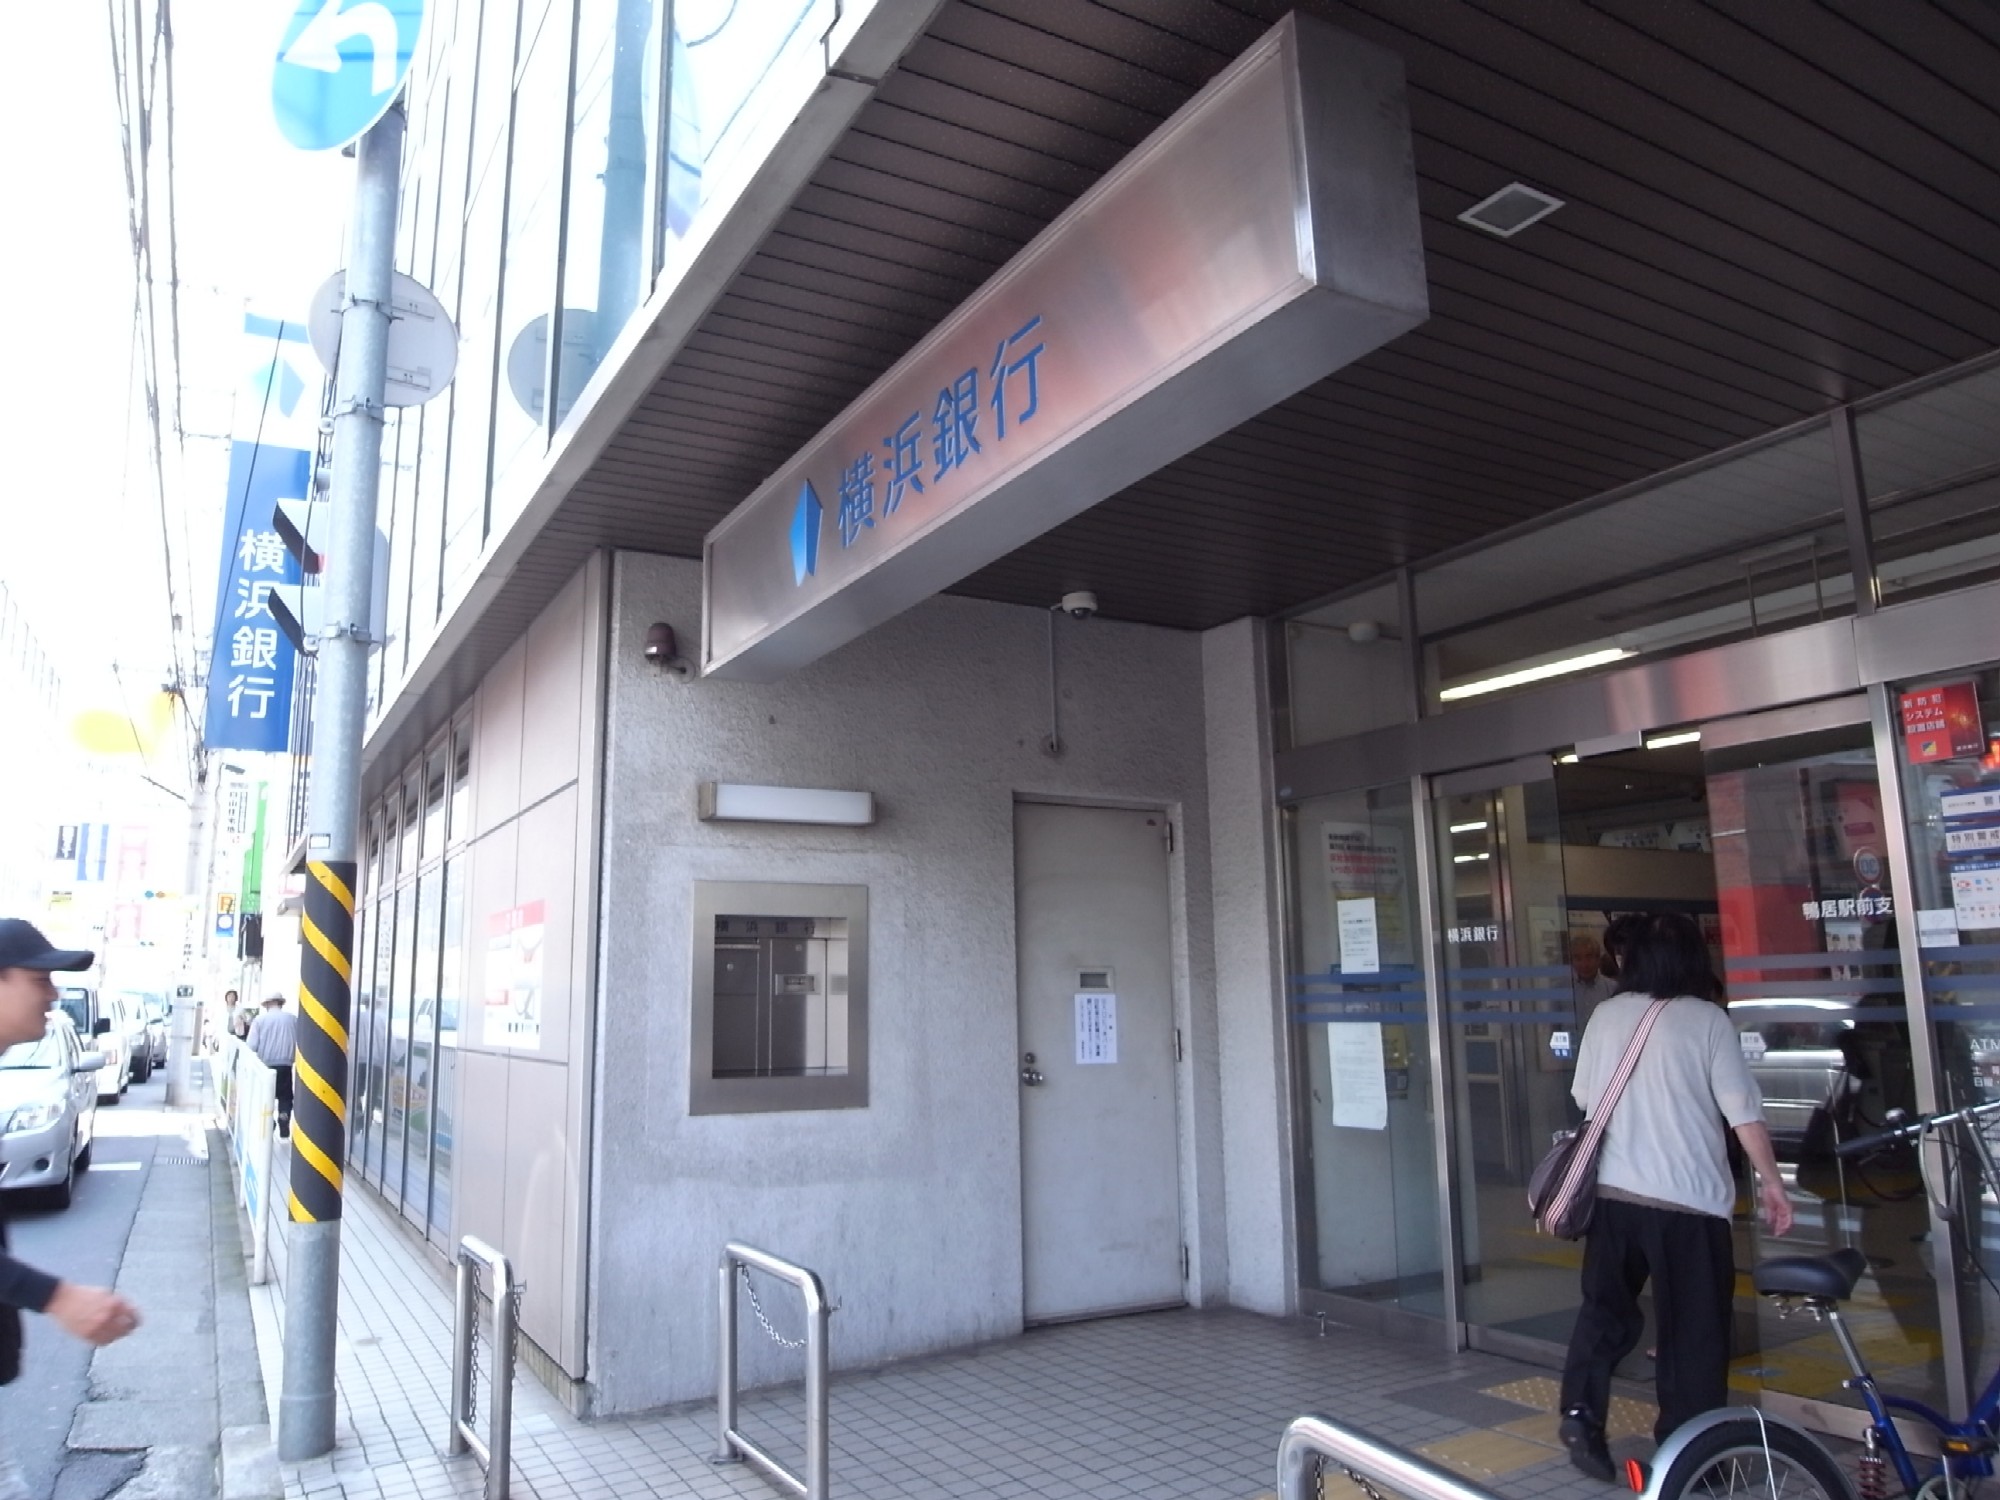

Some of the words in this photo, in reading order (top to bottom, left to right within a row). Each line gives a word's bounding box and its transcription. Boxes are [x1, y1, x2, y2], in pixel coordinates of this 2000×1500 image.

[837, 314, 1046, 549] 横浜銀行
[228, 529, 287, 718] 横浜銀行
[1905, 707, 1943, 721] システム
[1448, 925, 1498, 943] 横浜銀行
